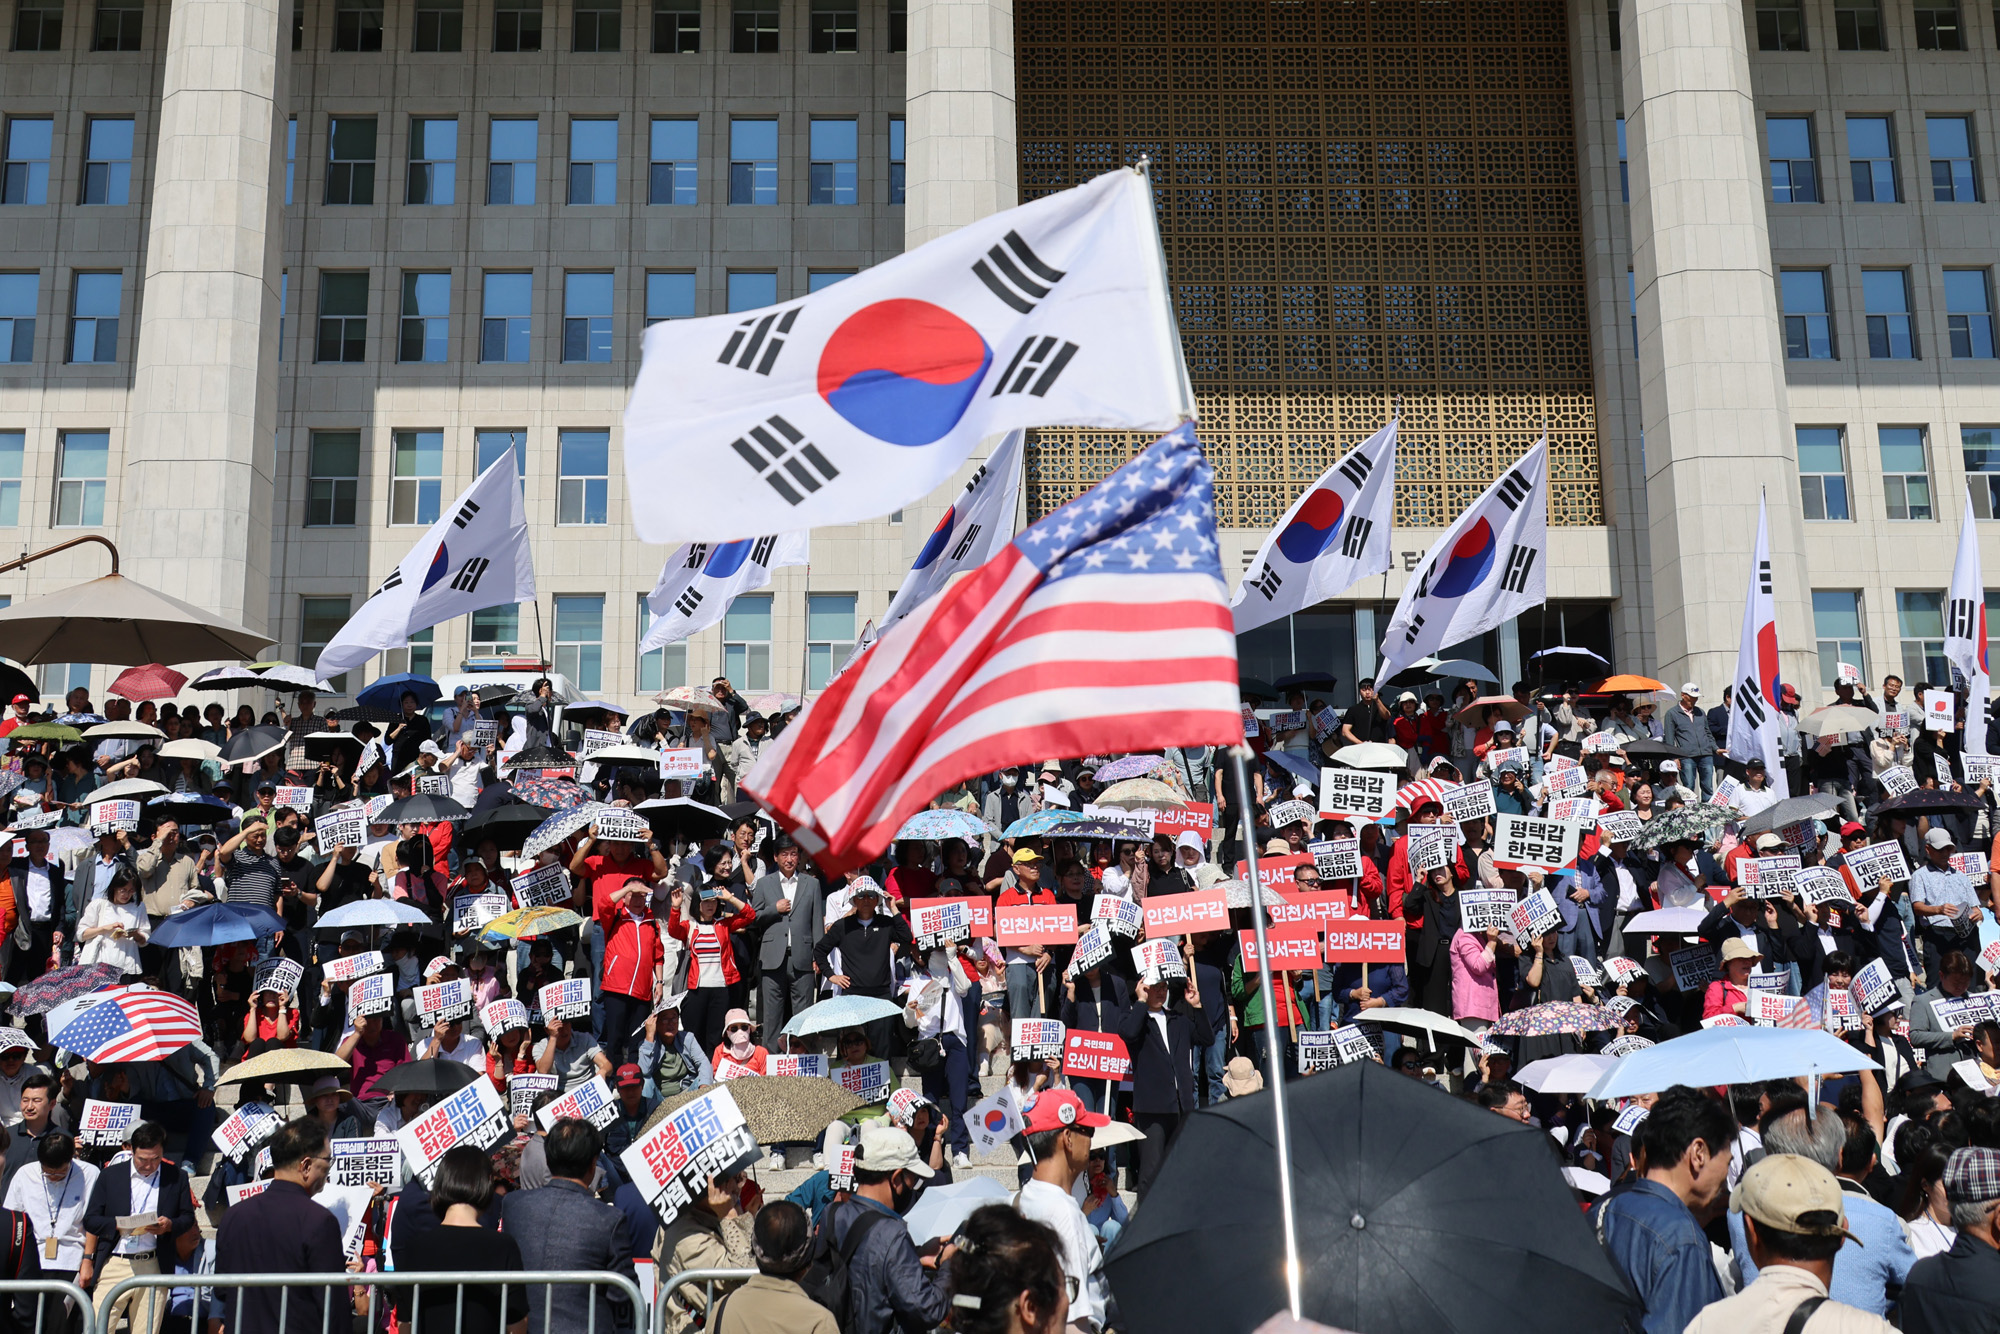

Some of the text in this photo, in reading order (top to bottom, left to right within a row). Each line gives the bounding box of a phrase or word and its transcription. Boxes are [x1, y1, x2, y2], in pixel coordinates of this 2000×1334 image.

[1930, 712, 1952, 722] 국민의힘
[1333, 774, 1385, 794] 평택갑
[1332, 792, 1383, 813] 한무경
[1447, 792, 1488, 810] 대통령은
[1510, 820, 1566, 842] 평택갑
[1508, 841, 1564, 864] 한무경
[1848, 842, 1900, 866] 정책실패·인사참사
[1855, 855, 1901, 877] 대통령은
[1863, 867, 1906, 888] 사죄하라
[1461, 892, 1516, 904] 정책실패·인사참사
[1511, 893, 1542, 922] 민생파탄
[921, 904, 961, 924] 민생파탄
[1146, 901, 1224, 926] 인천서구갑
[1271, 902, 1346, 922] 인천서구갑
[1515, 904, 1548, 933] 헌정파괴
[922, 915, 962, 934] 헌정파괴
[1000, 916, 1074, 934] 인천서구갑
[918, 926, 970, 950] 강력 규탄한다
[1329, 932, 1402, 950] 인천서구갑
[422, 981, 461, 1002] 민생파탄
[545, 980, 583, 998] 민생파탄
[1862, 983, 1896, 1013] 규탄한다
[423, 992, 462, 1012] 헌정파괴
[546, 990, 583, 1010] 헌정파괴
[420, 1002, 471, 1028] 강력 규탄한다
[556, 1002, 591, 1020] 규탄한다
[1022, 1022, 1060, 1033] 민생파탄
[1020, 1033, 1060, 1044] 헌정파괴
[1083, 1039, 1114, 1051] 국민의힘
[777, 1056, 818, 1070] 민생파탄
[1013, 1046, 1030, 1061] 강력
[1066, 1052, 1097, 1071] 오산시
[1304, 1047, 1340, 1060] 대통령
[842, 1064, 882, 1082] 민생파탄
[552, 1082, 597, 1116] 민생파탄
[90, 1106, 134, 1118] 민생파탄
[414, 1085, 478, 1144] 민생파탄
[421, 1102, 488, 1162] 헌정파괴
[642, 1096, 714, 1167] 민생파탄
[232, 1144, 250, 1165] 강력
[334, 1141, 398, 1154] 정책실패·인사참사
[651, 1115, 724, 1188] 헌정파괴
[337, 1155, 393, 1172] 대통령은
[337, 1171, 394, 1187] 사죄하라
[654, 1125, 752, 1226] 강력 규탄한다
[830, 1174, 851, 1192] 강력
[15, 1221, 24, 1246] Canon
